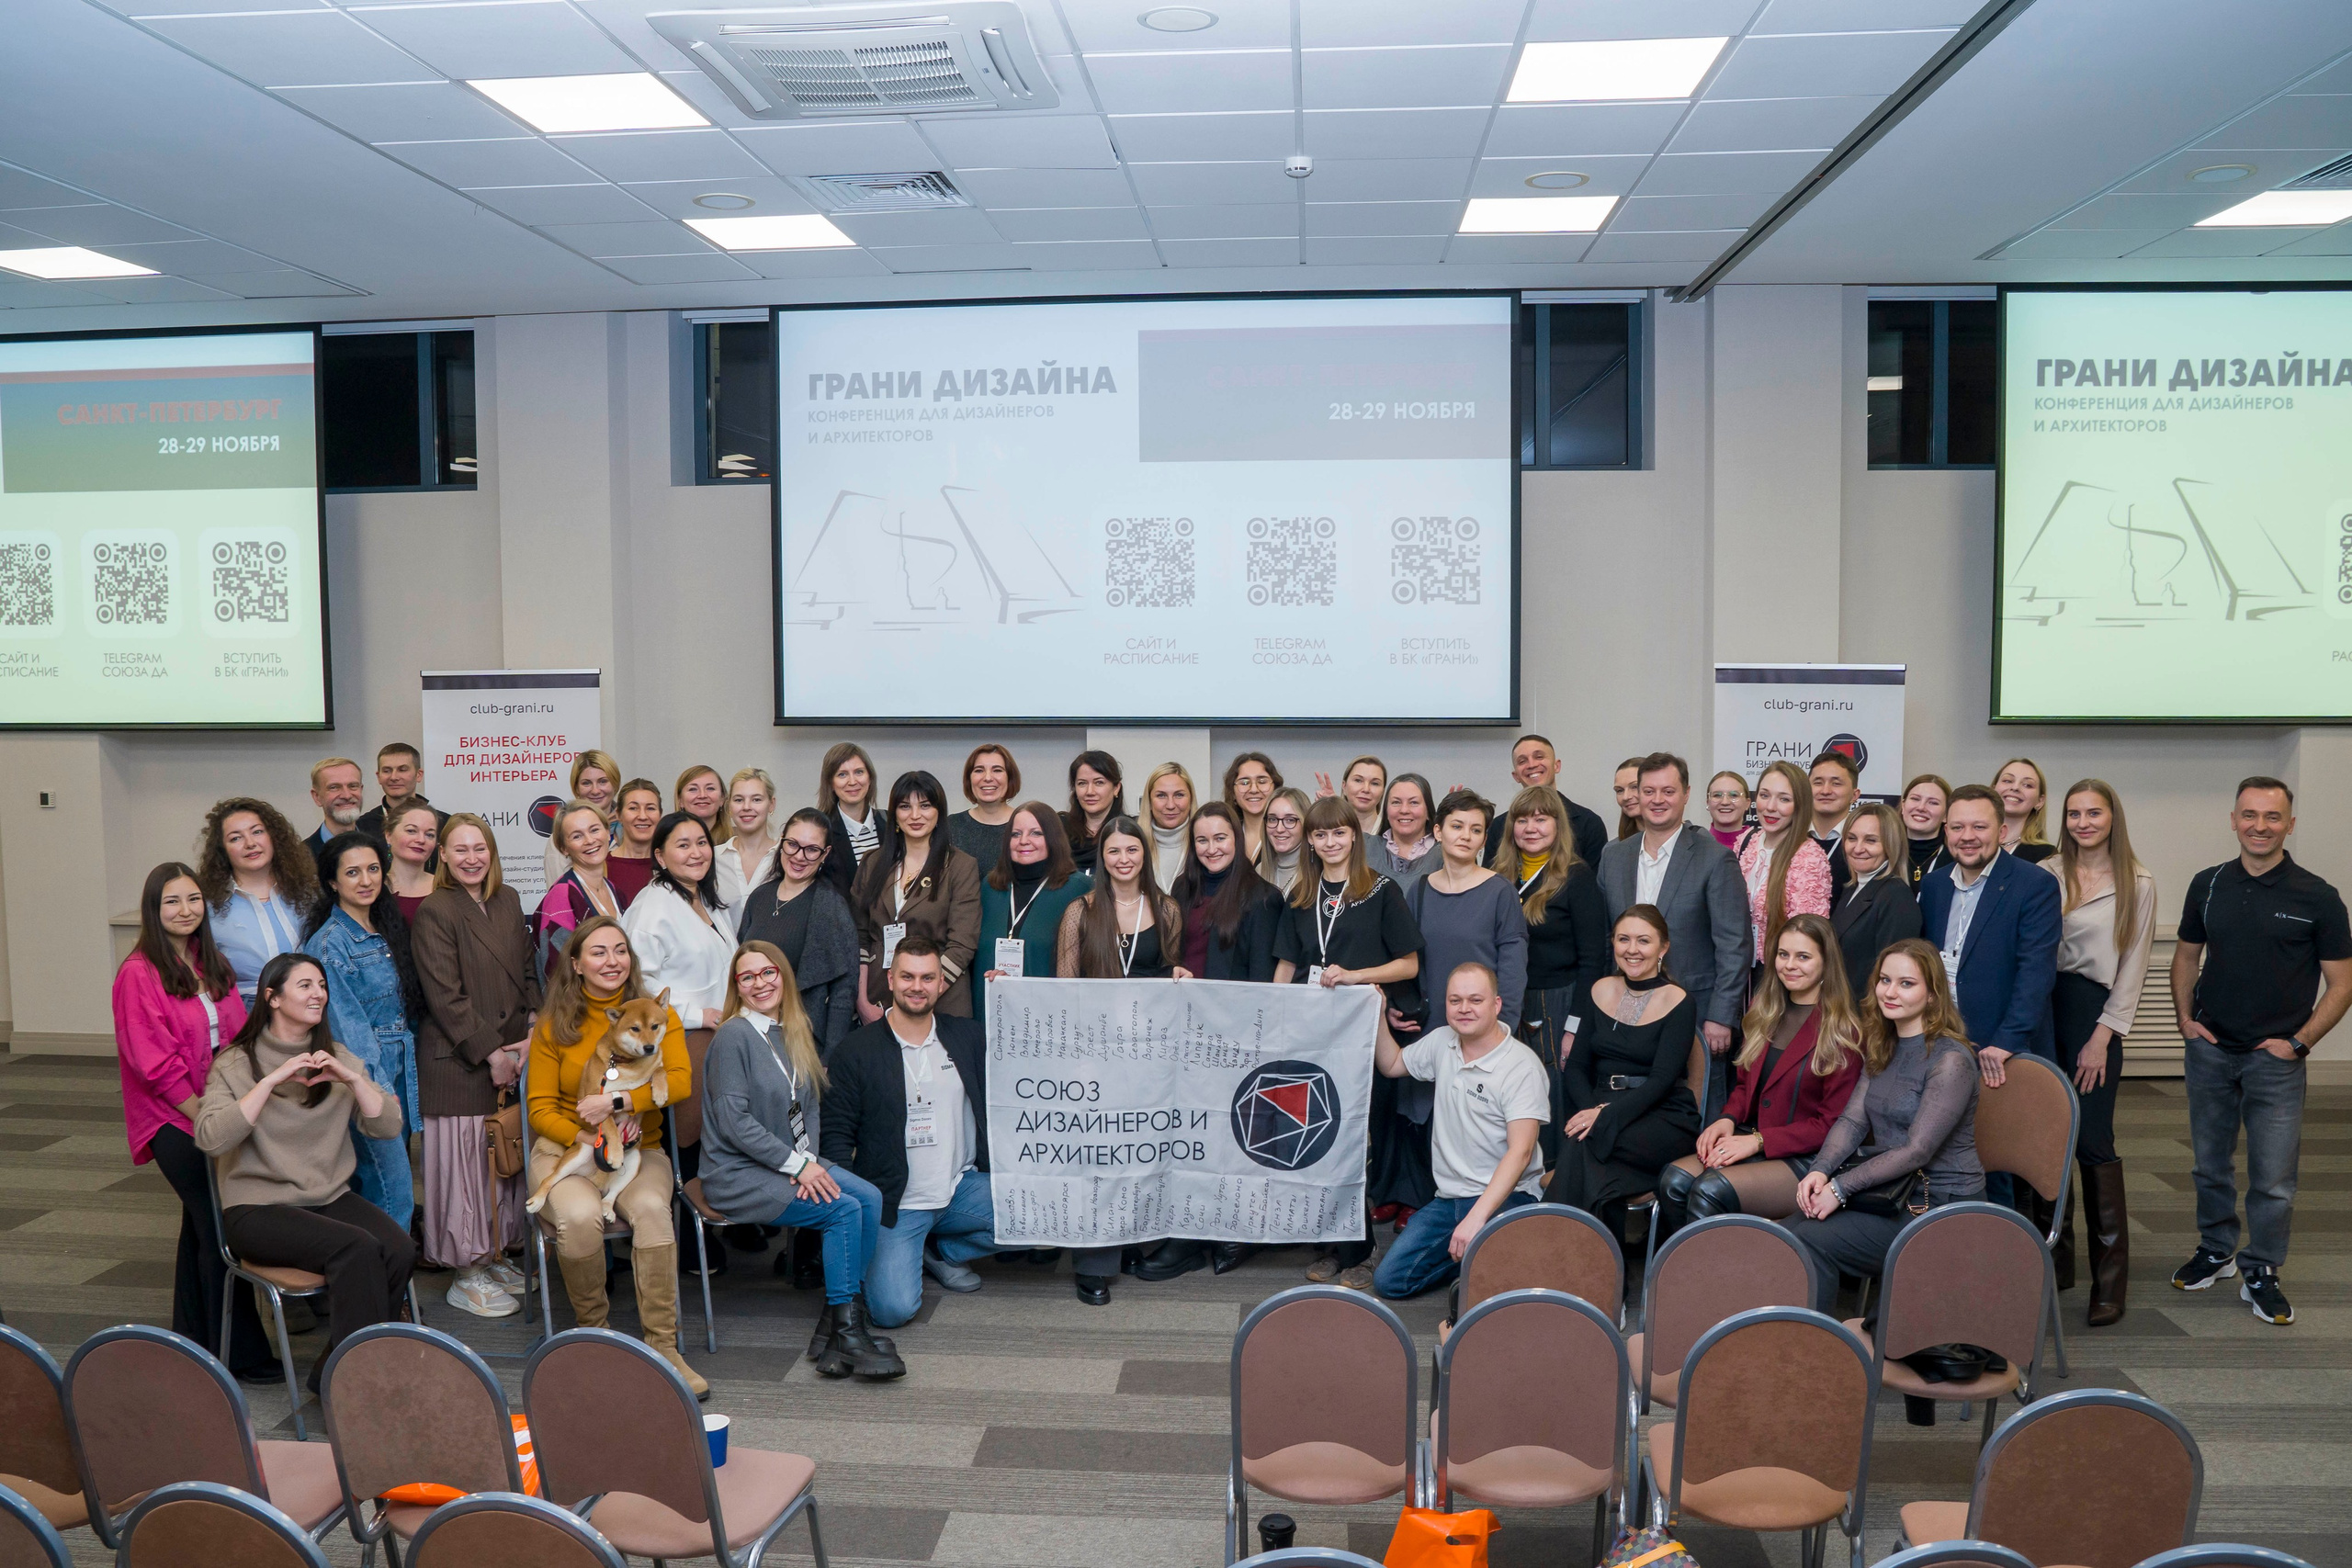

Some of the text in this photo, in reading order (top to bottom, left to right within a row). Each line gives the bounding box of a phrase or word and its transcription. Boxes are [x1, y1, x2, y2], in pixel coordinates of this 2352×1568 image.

[808, 359, 1117, 402] ГРАНИ ДИЗАЙНА
[2036, 351, 2352, 392] ГРАНИ ДИЗАЙНА
[57, 399, 282, 425] САНКТ-ПЕТЕРБУРГ
[808, 403, 1054, 423] КОНФЕРЕНЦИЯ ДЛЯ ДИЗАЙНЕРОВ
[1329, 401, 1476, 420] 28-29 НОЯБРЯ
[2034, 394, 2293, 412] КОНФЕРЕНЦИЯ ДЛЯ ДИЗАЙНЕРОВ
[808, 429, 933, 444] И АРХИТЕКТОРОВ
[2034, 420, 2166, 433] И АРХИТЕКТОРОВ
[158, 435, 280, 454] 28-29 НОЯБРЯ
[0, 650, 40, 664] САЙТ И
[104, 653, 162, 664] TELEGRAM
[223, 652, 282, 664] ВСТУПИТЬ
[1103, 652, 1199, 665] РАСПИСАНИЕ
[1125, 636, 1176, 650] САЙТ И
[1252, 652, 1333, 666] СОЮЗА ДА
[1254, 637, 1327, 650] TELEGRAM
[1390, 652, 1478, 665] В БК «ГРАНИ»
[1401, 637, 1471, 650] ВСТУПИТЬ
[102, 667, 168, 679] СОЮЗА ДА
[215, 666, 288, 678] В БК «ГРАНИ»
[470, 703, 554, 716] club-grani.ru
[1764, 699, 1853, 713] club-grani.ru
[459, 735, 566, 748] БИЗНЕС-КЛУБ
[1747, 741, 1812, 758] ГРАНИ
[444, 754, 475, 768] ДЛЯ
[470, 770, 558, 783] ИНТЕРЬЕРА
[1746, 761, 1810, 769] БИЗНЛУБ
[481, 811, 519, 827] АНИ
[993, 993, 1005, 1061] Симферополь
[1019, 1006, 1033, 1058] Владимир
[1032, 1019, 1042, 1059] Кемерово
[1044, 1013, 1054, 1059] Хабаровск
[1057, 1009, 1068, 1060] Махачкала
[1070, 1023, 1083, 1060] Сургут
[1083, 1024, 1097, 1058] Брест
[1097, 1013, 1110, 1062] Душанбе
[1112, 1025, 1125, 1059] Гагра
[1128, 999, 1138, 1061] Севастополь
[1141, 1017, 1154, 1061] Воронеж
[1157, 1026, 1170, 1061] Киров
[1251, 1008, 1263, 1069] Ростов-на-Дону
[1189, 1022, 1204, 1066] Липецк
[1201, 1034, 1216, 1068] Самара
[1211, 1033, 1223, 1067] Шанхай
[1219, 1042, 1229, 1068] Санья
[1239, 1052, 1252, 1070] Уфа
[1015, 1077, 1100, 1101] СОЮЗ
[1016, 1109, 1207, 1134] ДИЗАЙНЕРОВ И
[1018, 1140, 1204, 1165] АРХИТЕКТОРОВ
[1150, 1172, 1166, 1232] Екатеринбург
[1214, 1176, 1228, 1203] Хутор
[1225, 1178, 1242, 1233] Барселона
[1259, 1177, 1271, 1213] Байкал
[1004, 1188, 1017, 1237] Ярославль
[1028, 1190, 1041, 1235] Краснодар
[1041, 1204, 1050, 1237] Минск
[1048, 1200, 1059, 1239] Иваново
[1060, 1181, 1071, 1240] Красноярск
[1087, 1175, 1103, 1240] Нижний Новгород
[1102, 1202, 1114, 1239] Милан
[1117, 1186, 1127, 1238] озеро Комо
[1128, 1181, 1141, 1236] Санкт-Петербург
[1139, 1192, 1154, 1233] Барнаул
[1164, 1204, 1176, 1230] Тверь
[1177, 1194, 1195, 1231] Казань
[1194, 1204, 1205, 1231] Сочи
[1243, 1190, 1259, 1235] Иркутск
[1268, 1199, 1282, 1235] Пенза
[1297, 1193, 1310, 1235] Ташкент
[1311, 1187, 1332, 1235] Самарканд
[1326, 1201, 1340, 1234] Ереван
[1342, 1195, 1357, 1233] Тюмень
